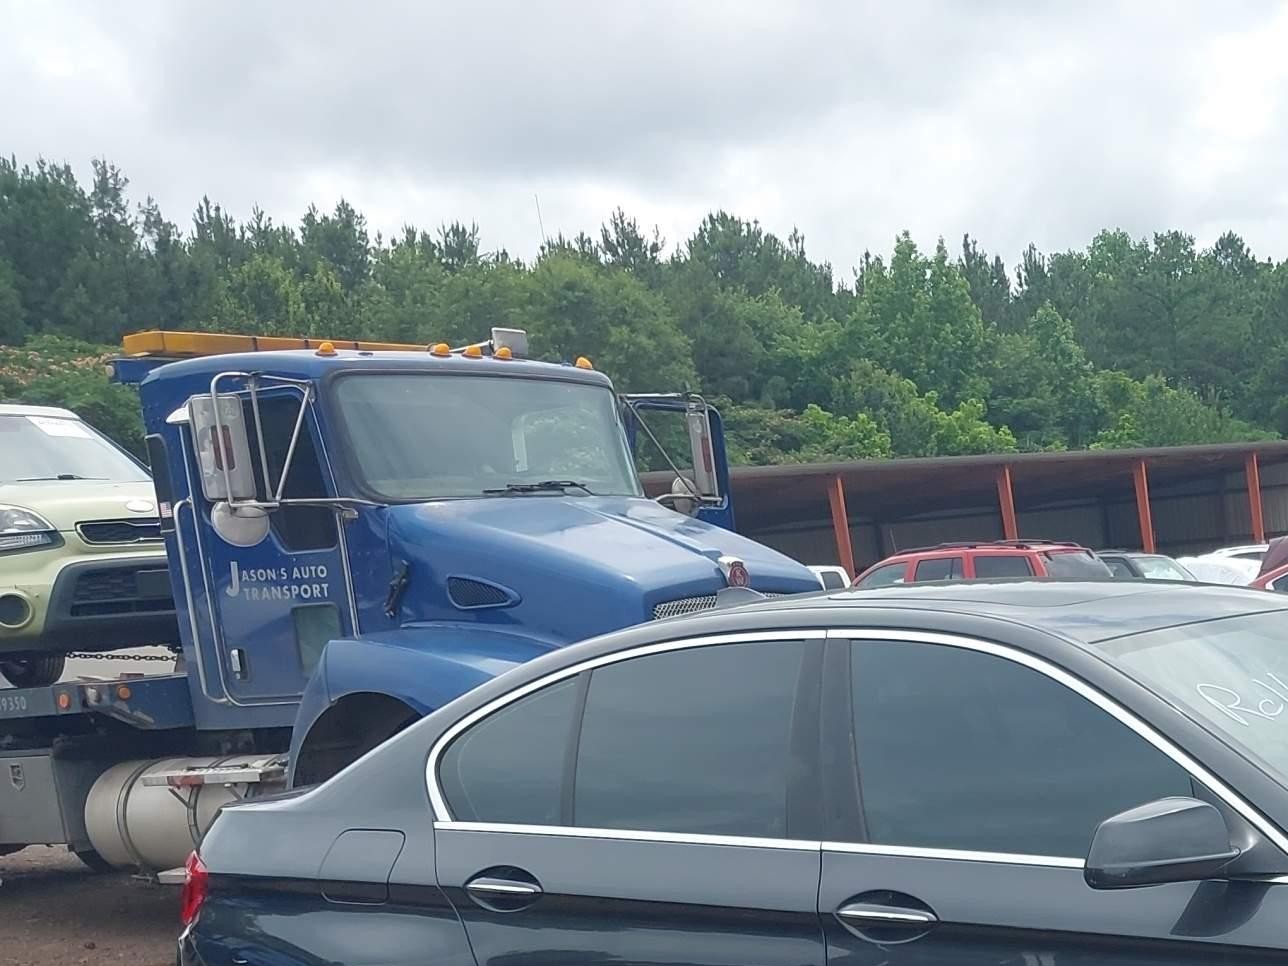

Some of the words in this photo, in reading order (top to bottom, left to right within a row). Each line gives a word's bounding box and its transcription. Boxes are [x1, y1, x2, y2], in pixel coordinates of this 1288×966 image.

[226, 561, 287, 597] JASON'S
[292, 565, 328, 579] AUTO
[243, 583, 329, 601] TRANSPORT
